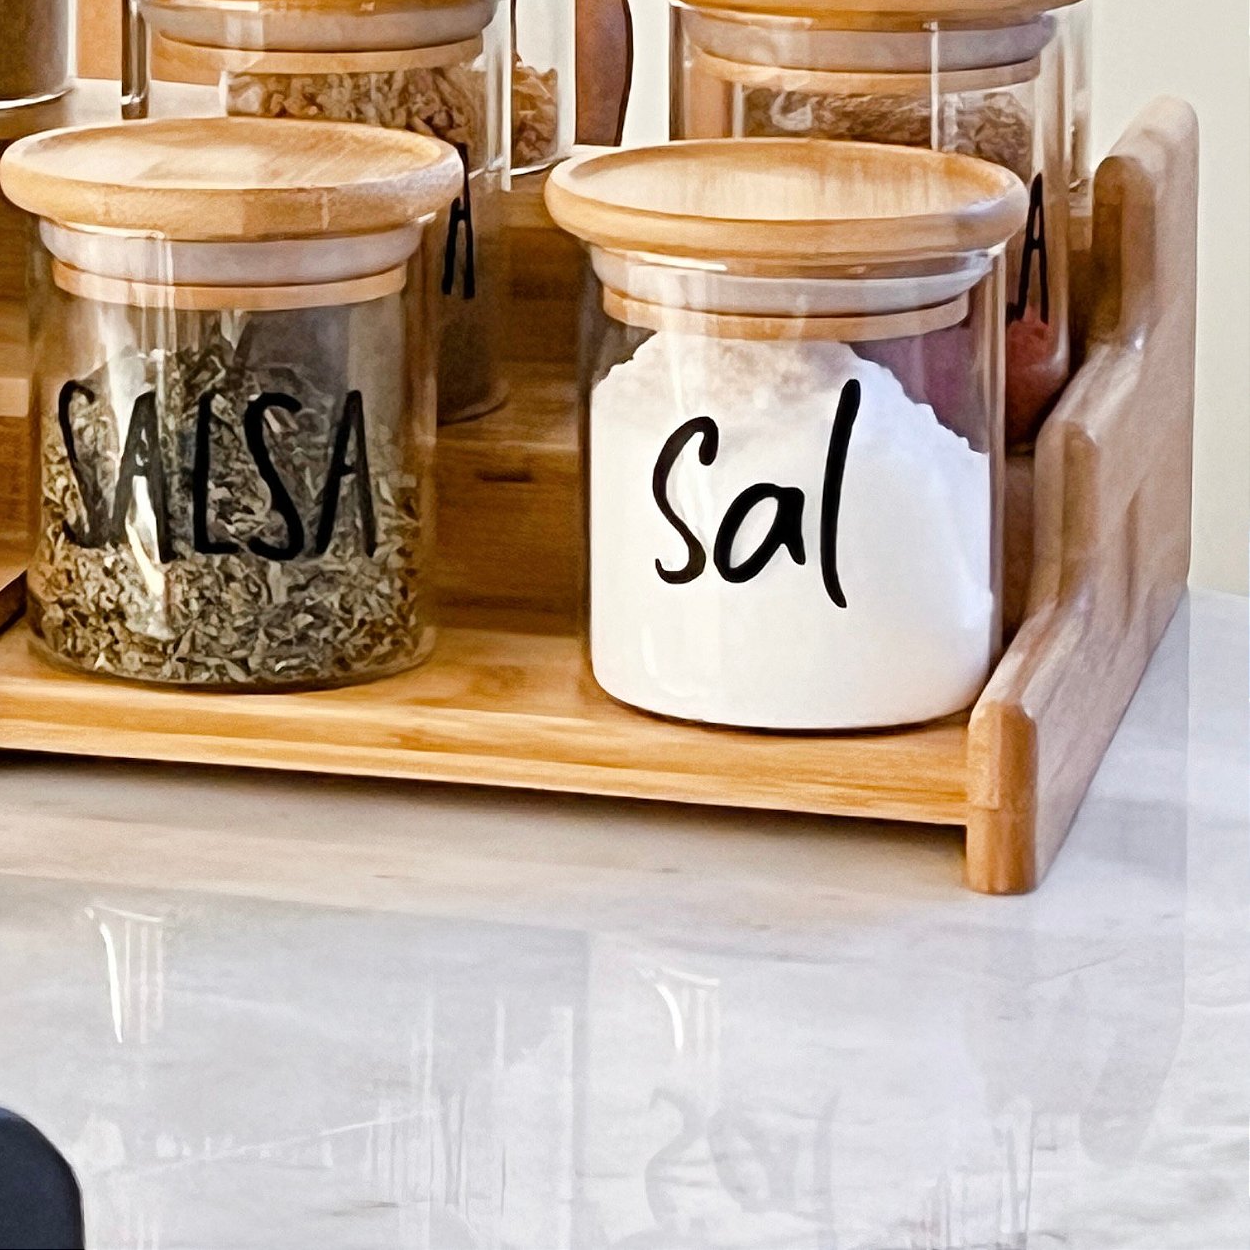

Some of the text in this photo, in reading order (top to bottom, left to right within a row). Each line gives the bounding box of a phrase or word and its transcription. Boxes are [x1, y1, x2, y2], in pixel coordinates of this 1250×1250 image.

[1006, 172, 1049, 327] A
[58, 380, 377, 564] SALSA
[652, 378, 861, 608] Sal
